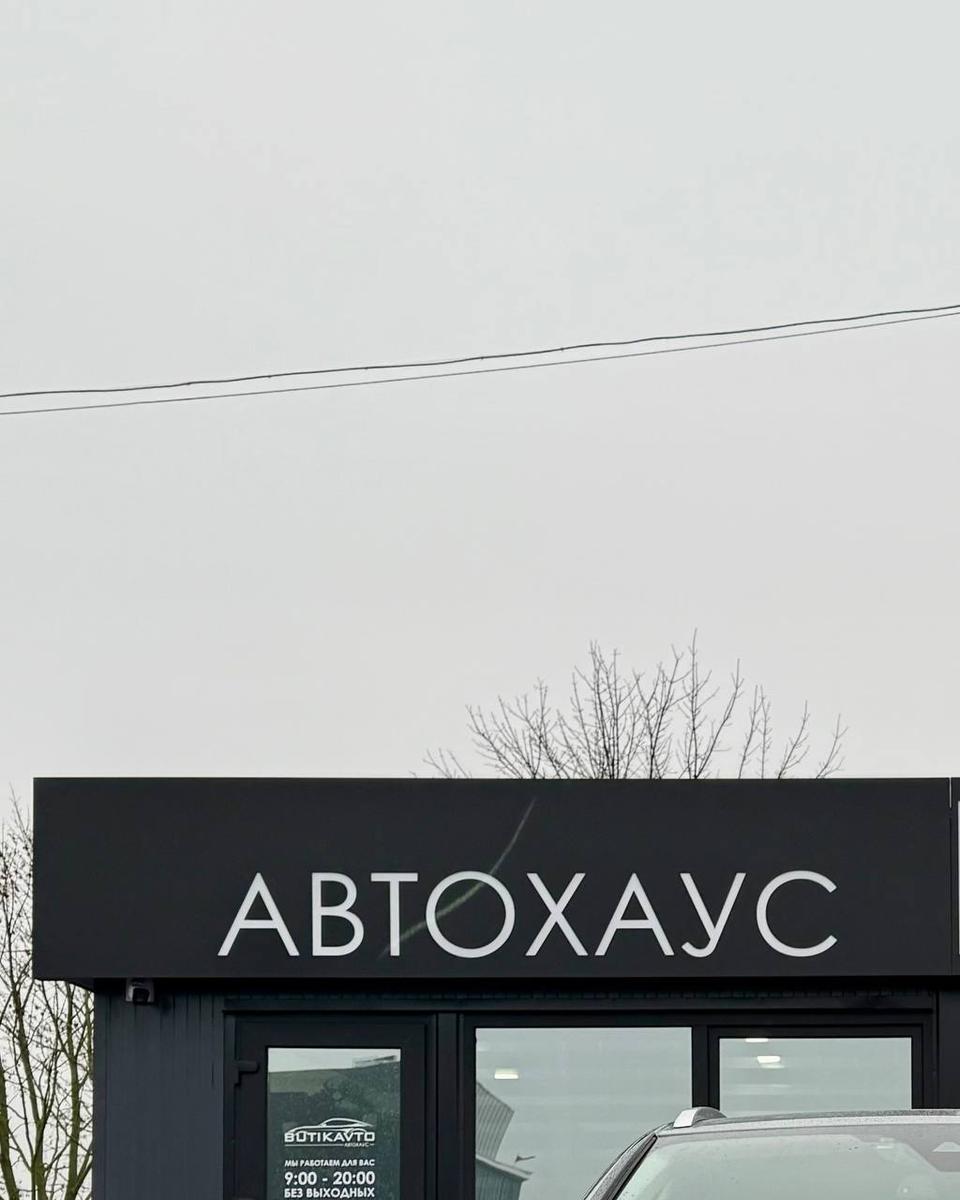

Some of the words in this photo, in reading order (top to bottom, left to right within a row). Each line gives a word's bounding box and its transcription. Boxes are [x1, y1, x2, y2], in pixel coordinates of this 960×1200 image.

[217, 870, 838, 959] АВТОХАУС
[284, 1131, 376, 1142] BUTIKAVTO
[284, 1171, 317, 1185] 9:00
[333, 1171, 376, 1185] 20:00
[284, 1188, 303, 1198] БЕЗ
[306, 1187, 375, 1198] ВЫХОДНЫХ
